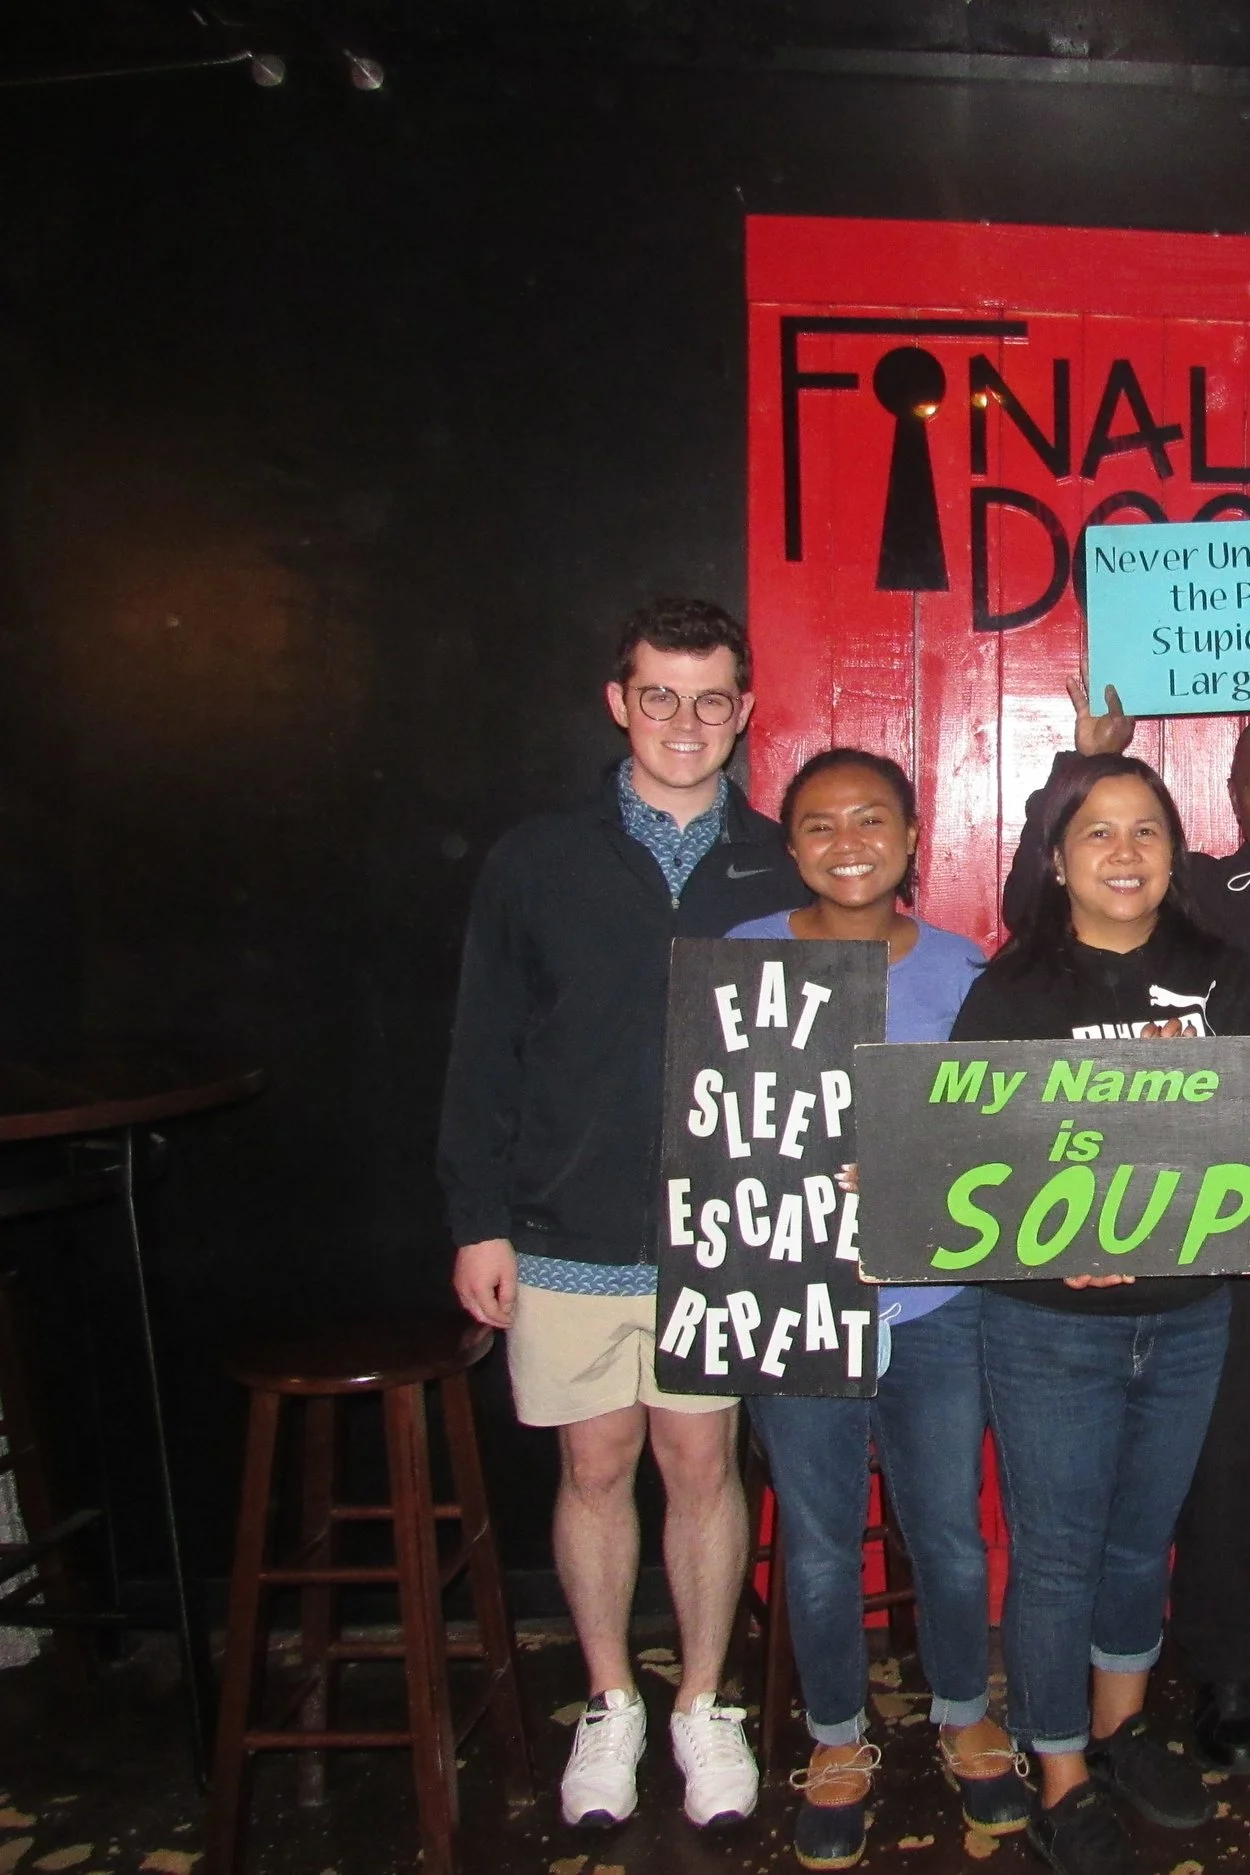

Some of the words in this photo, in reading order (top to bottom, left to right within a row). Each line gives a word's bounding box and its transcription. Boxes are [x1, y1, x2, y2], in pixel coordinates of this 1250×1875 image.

[1095, 545, 1199, 574] Never
[1170, 583, 1228, 611] the
[715, 961, 832, 1052] EAT
[688, 1068, 852, 1160] SLEEP
[929, 1060, 1026, 1115] My
[1042, 1060, 1219, 1103] Name
[1048, 1119, 1104, 1162] is
[668, 1174, 859, 1269] ESCAPE
[659, 1282, 870, 1378] REPEAT
